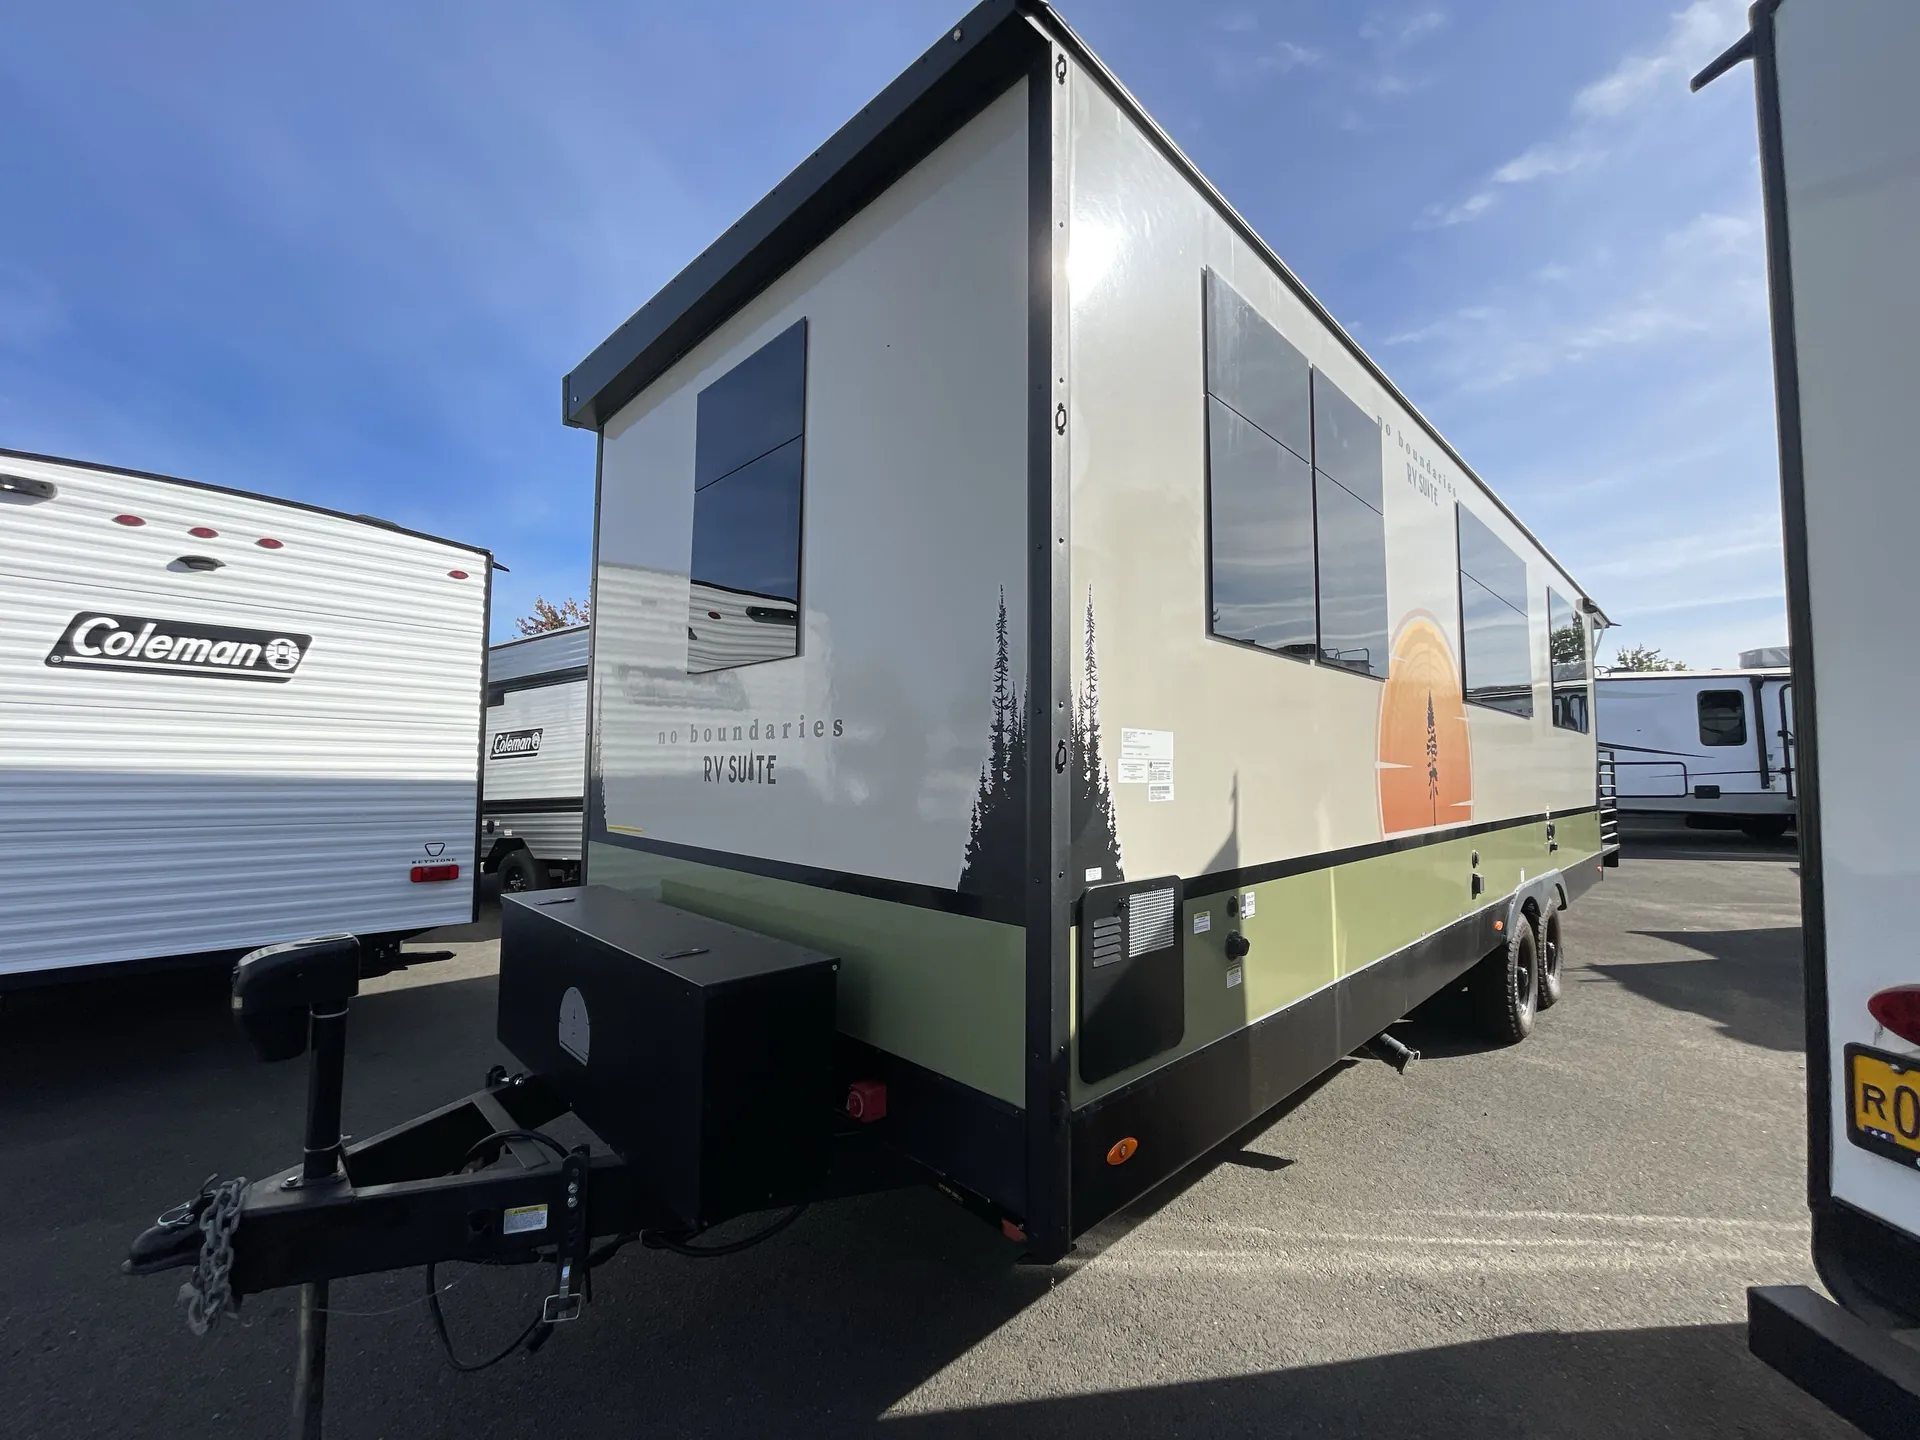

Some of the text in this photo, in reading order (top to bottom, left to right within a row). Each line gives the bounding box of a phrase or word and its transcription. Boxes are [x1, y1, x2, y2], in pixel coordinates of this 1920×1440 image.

[72, 616, 262, 667] Coleman
[658, 714, 844, 744] no boundaries
[493, 733, 532, 754] Coleman
[411, 857, 457, 865] KEYSTONE
